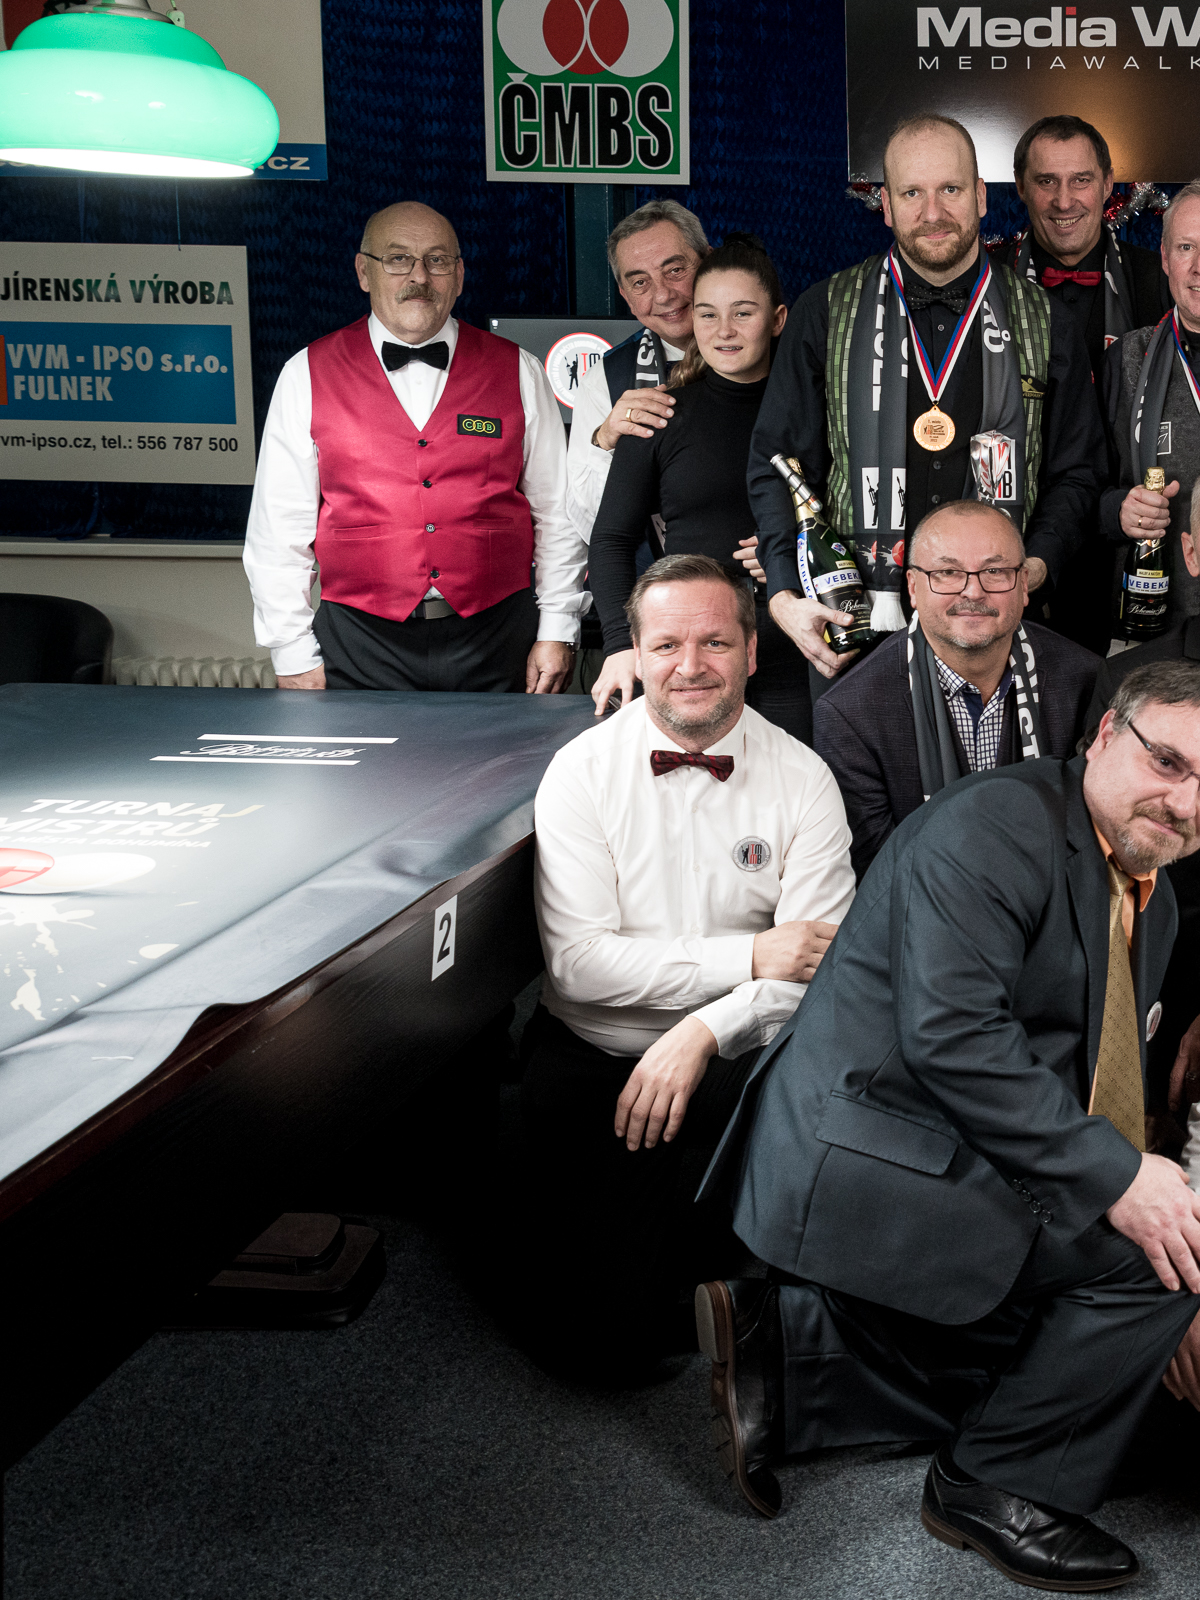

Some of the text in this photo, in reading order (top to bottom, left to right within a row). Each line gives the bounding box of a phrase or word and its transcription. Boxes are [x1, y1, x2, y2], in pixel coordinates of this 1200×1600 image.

[917, 6, 1117, 48] Media
[499, 72, 674, 170] ČMBS
[0, 271, 234, 306] JÍRENSKÁ VÝROBA
[7, 343, 69, 370] VVM
[93, 344, 153, 372] IPSO
[160, 353, 228, 373] s.r.o.
[13, 374, 113, 401] FULNEK
[101, 435, 133, 450] tel.:
[137, 436, 167, 450] 556
[172, 437, 203, 451] 787
[208, 438, 238, 452] 500
[20, 799, 266, 818] TURNAJ
[0, 817, 221, 837] MISTRŮ
[436, 912, 452, 964] 2
